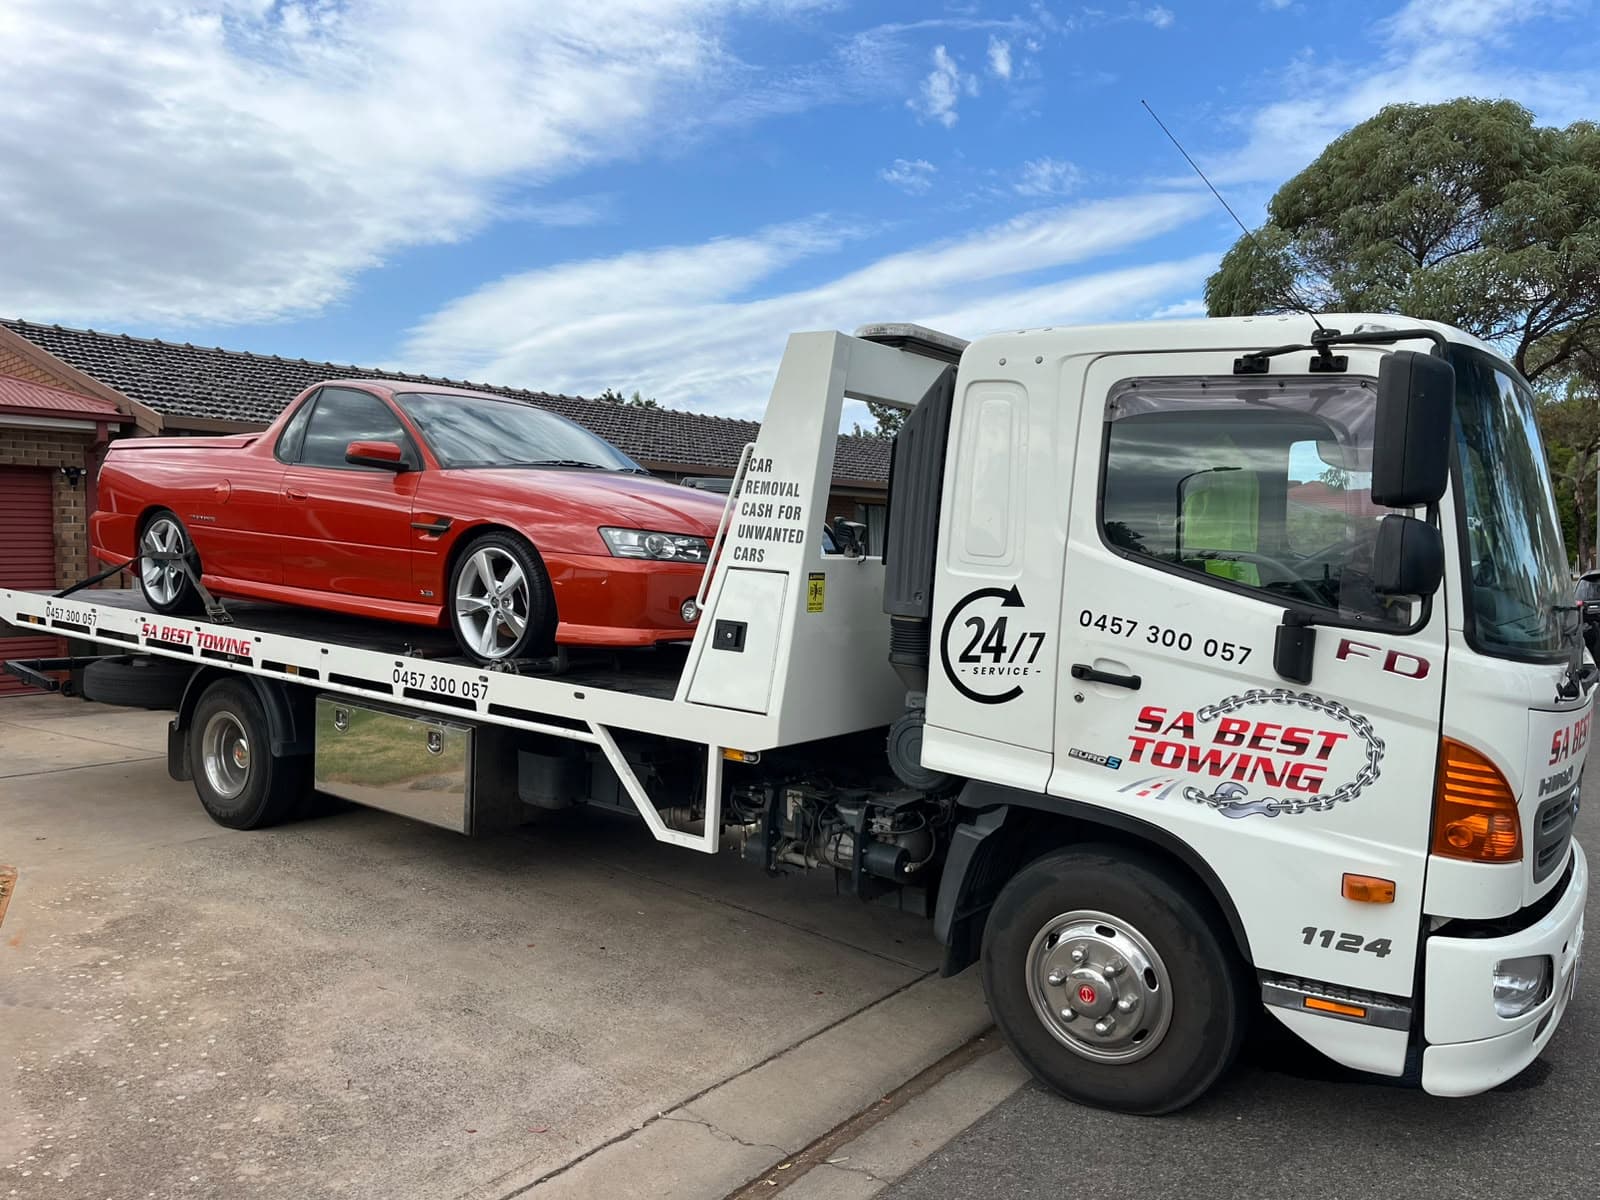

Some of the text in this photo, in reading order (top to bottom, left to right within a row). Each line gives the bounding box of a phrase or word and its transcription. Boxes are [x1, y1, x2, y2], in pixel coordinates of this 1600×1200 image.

[749, 457, 773, 473] CAR
[745, 480, 800, 498] REMOVAL
[741, 502, 802, 520] CASH FOR
[738, 524, 804, 544] UNWANTED
[734, 546, 765, 563] CARS
[45, 606, 97, 626] 0457 300 057
[141, 623, 251, 657] SA BEST TOWING
[958, 616, 1046, 663] 24/7
[1079, 609, 1253, 665] 0457 300 057
[973, 667, 1029, 675] SERVICE
[1335, 638, 1431, 680] FD
[393, 669, 488, 700] 0457 300 057
[1134, 705, 1348, 761] SA BEST
[1548, 726, 1570, 766] SA
[1127, 735, 1328, 793] TOWING
[1301, 926, 1392, 958] 1124
